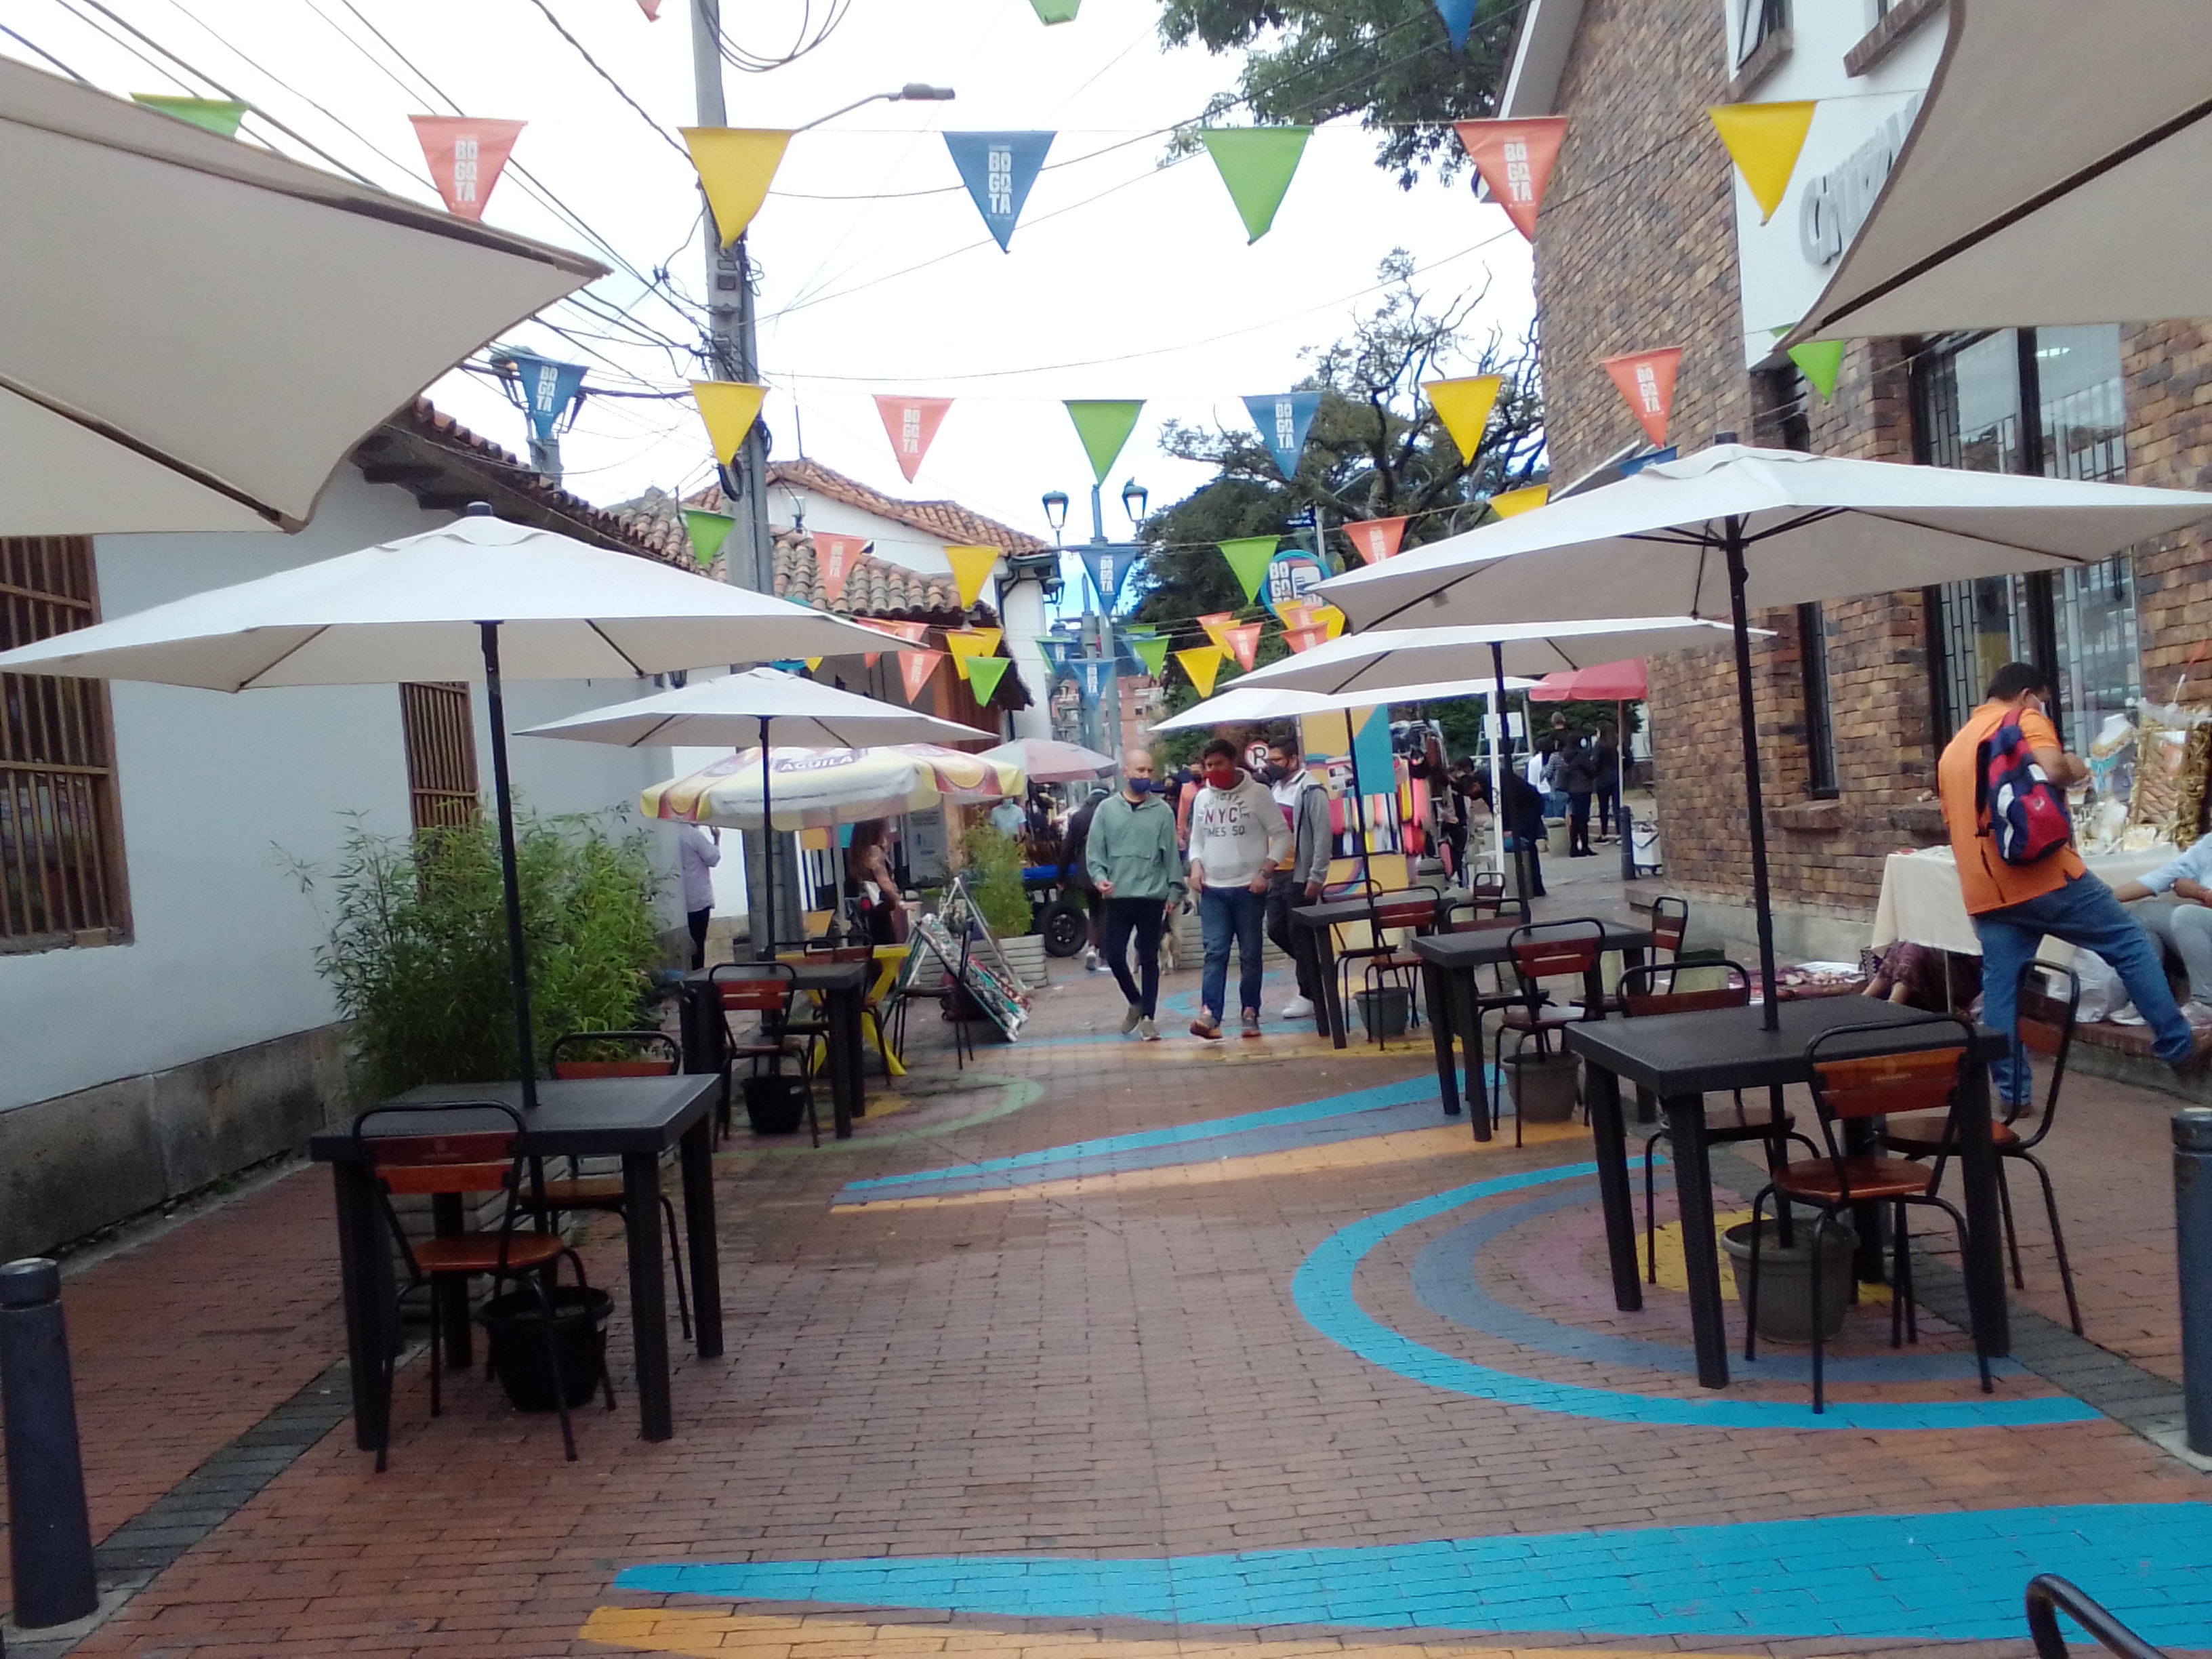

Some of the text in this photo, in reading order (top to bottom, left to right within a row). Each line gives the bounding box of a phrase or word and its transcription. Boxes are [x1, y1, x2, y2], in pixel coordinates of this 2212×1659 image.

[989, 151, 1012, 172] BO
[989, 172, 1012, 194] GO
[988, 193, 1011, 214] TA
[1205, 806, 1238, 824] NYC
